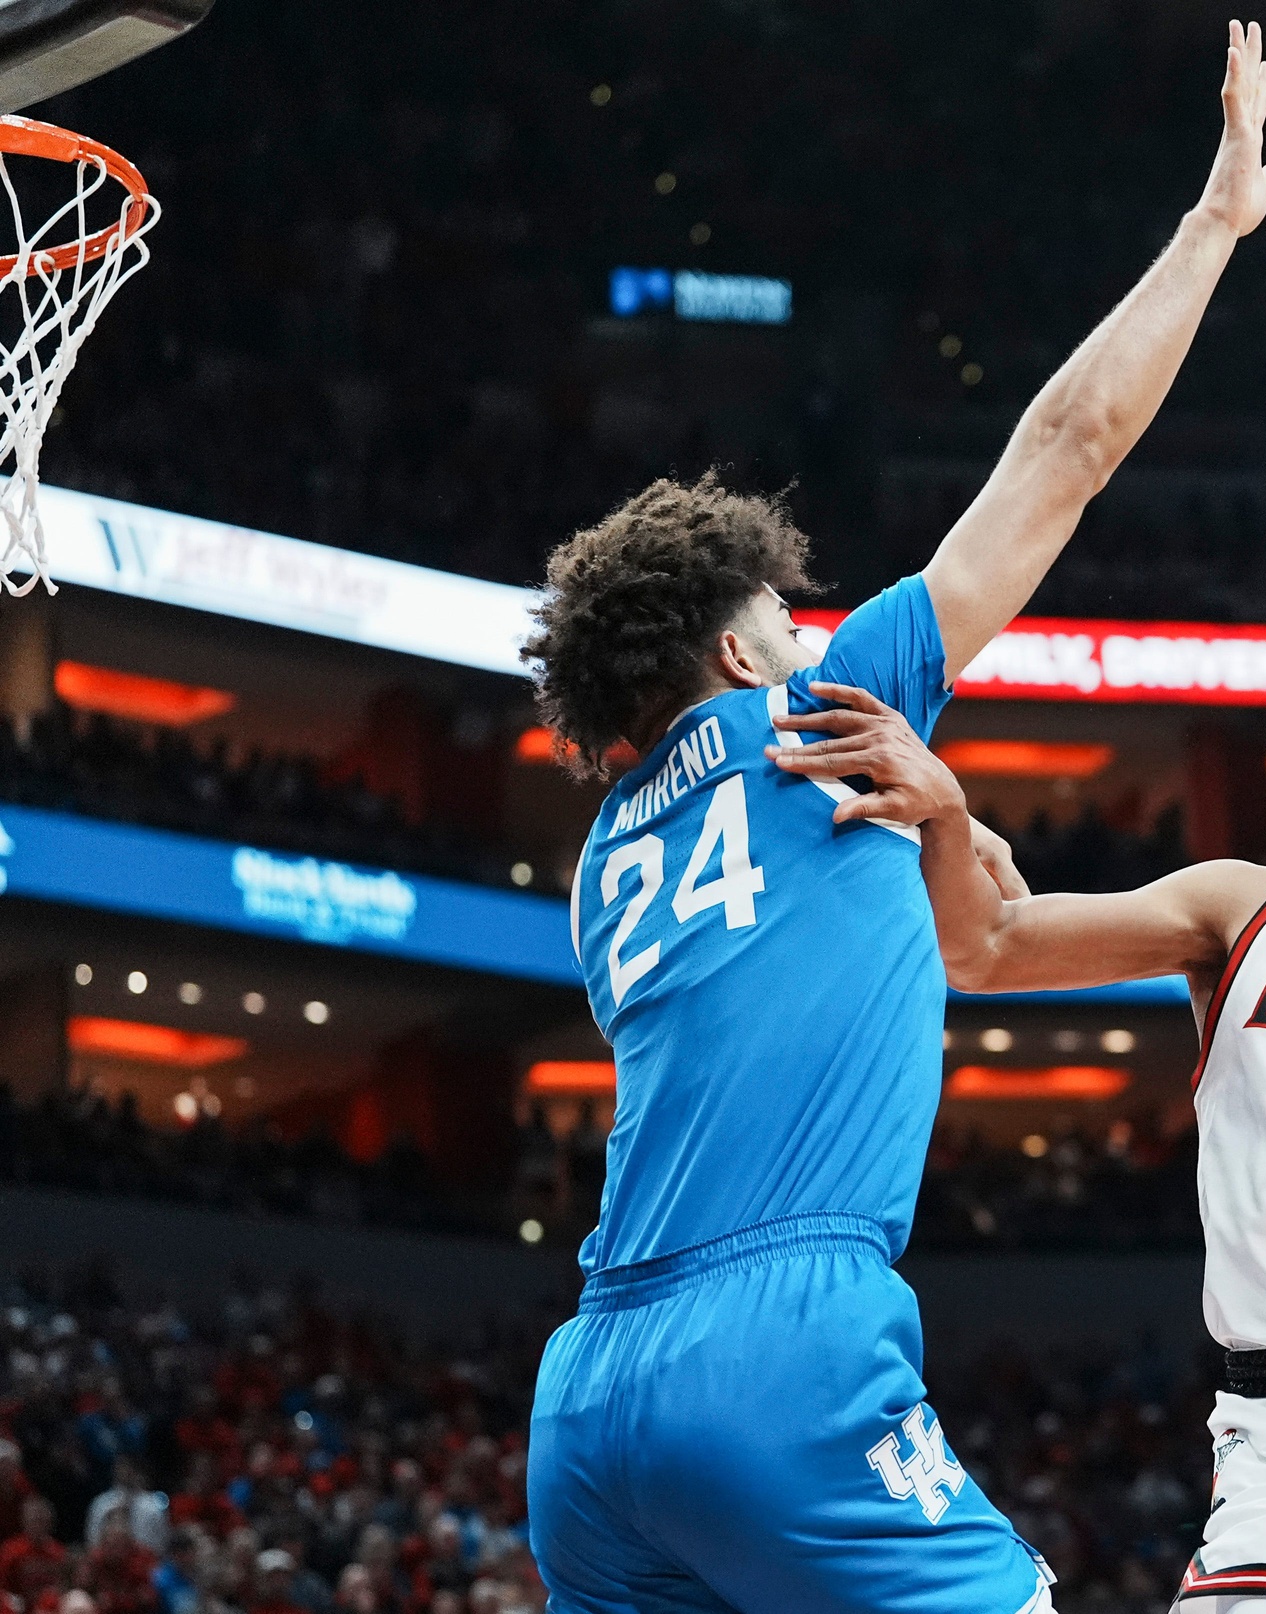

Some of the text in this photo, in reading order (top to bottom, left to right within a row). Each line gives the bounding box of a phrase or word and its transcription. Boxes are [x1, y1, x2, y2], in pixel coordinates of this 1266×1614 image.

[608, 716, 726, 839] MORENO
[600, 773, 765, 1009] 24
[865, 1402, 966, 1525] UK
